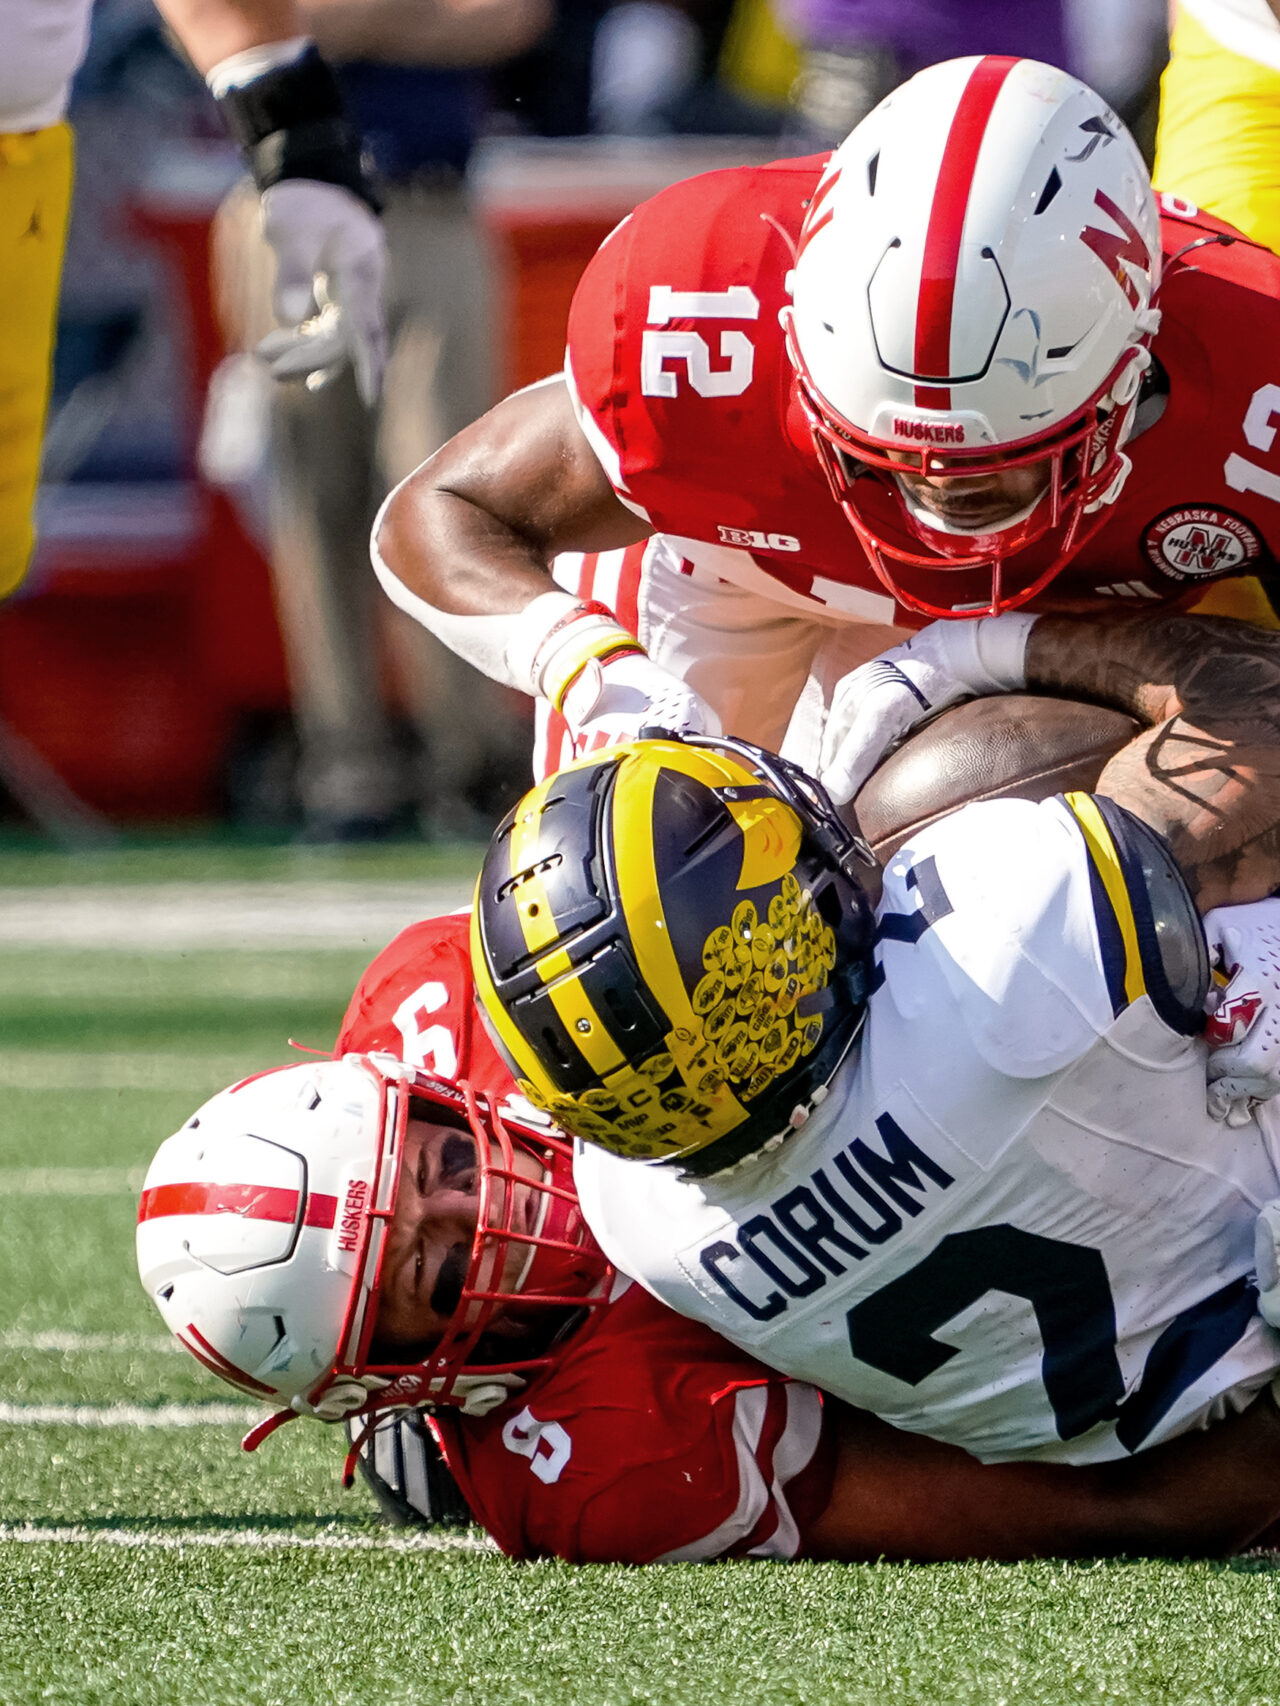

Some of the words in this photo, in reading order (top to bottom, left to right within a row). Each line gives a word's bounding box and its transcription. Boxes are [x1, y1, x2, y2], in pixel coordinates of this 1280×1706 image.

[1080, 188, 1152, 312] N
[641, 284, 760, 398] 12
[894, 418, 965, 444] HUSKERS
[1155, 509, 1219, 534] NEBRASKA
[1222, 518, 1260, 558] FOOTBALL
[1167, 537, 1238, 562] HUSKERS
[616, 1112, 651, 1133] MVP
[337, 1179, 369, 1252] HUSKERS
[699, 1111, 957, 1323] CORUM
